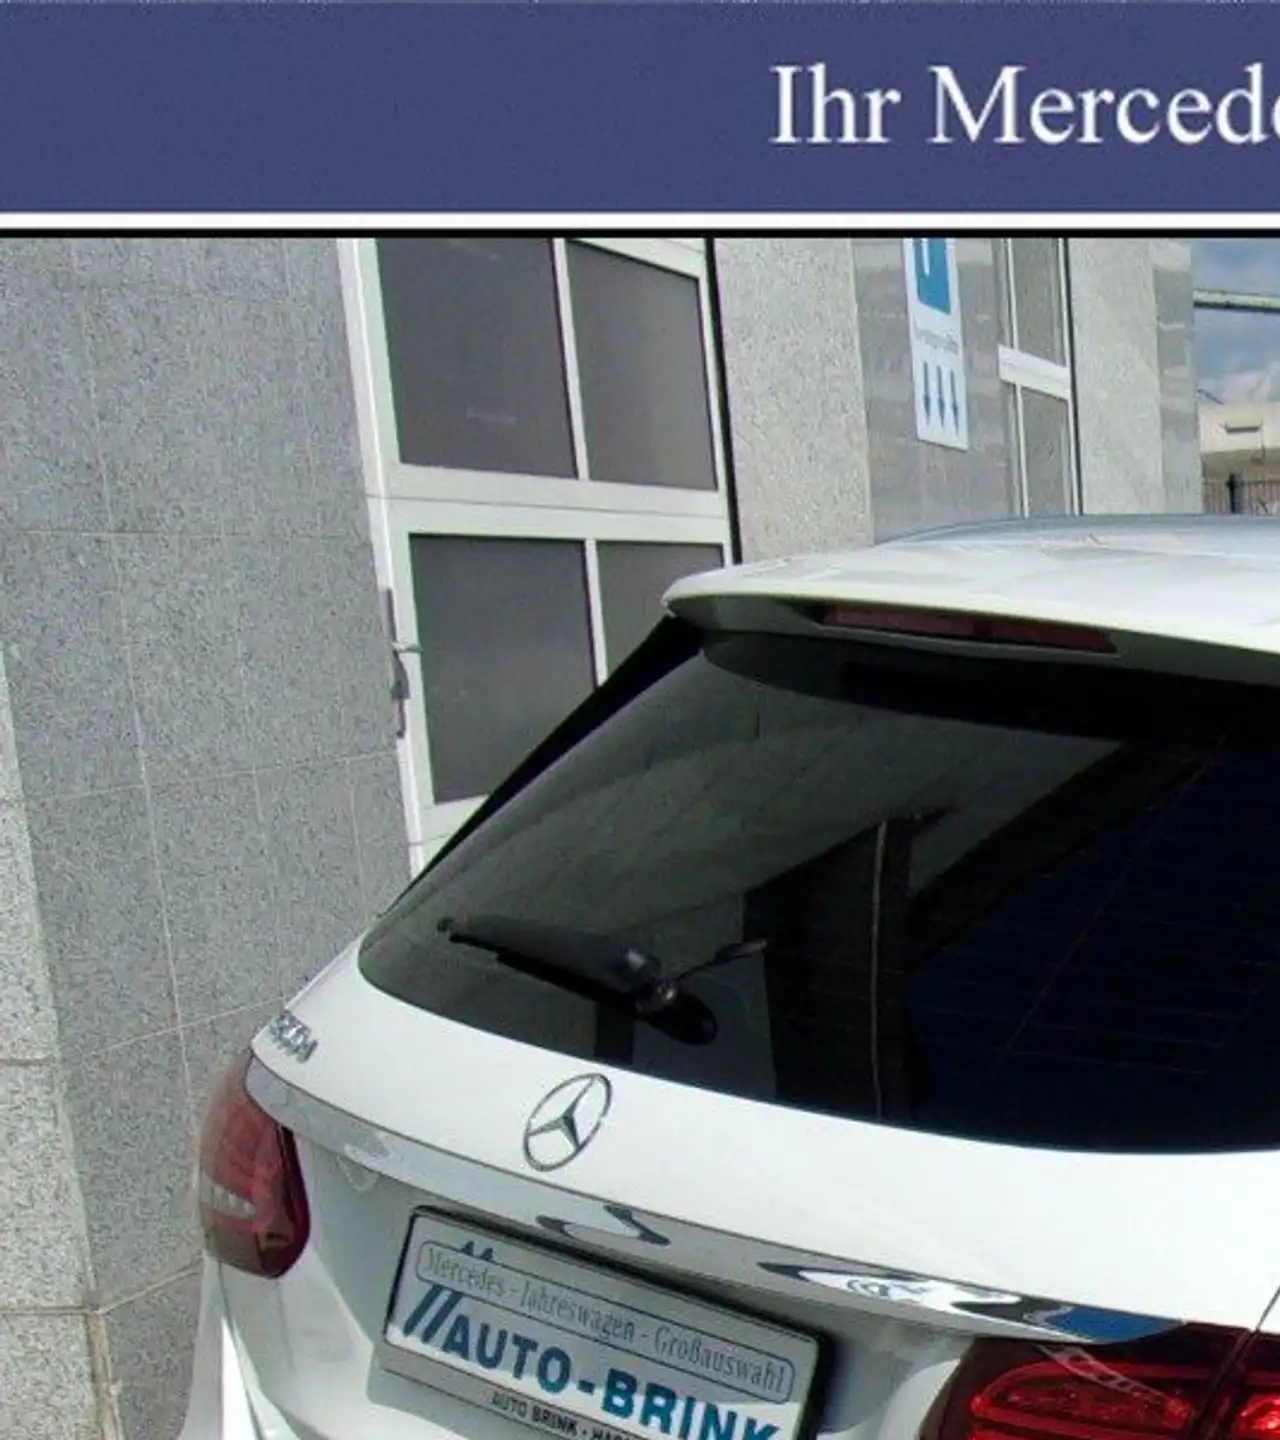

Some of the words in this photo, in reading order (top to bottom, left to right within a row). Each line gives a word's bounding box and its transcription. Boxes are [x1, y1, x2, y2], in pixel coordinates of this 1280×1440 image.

[424, 1247, 505, 1297] Mercedes
[519, 1279, 635, 1343] Jahreswagen
[655, 1325, 786, 1395] Großauswahl
[491, 1391, 527, 1418] AUTO
[531, 1404, 578, 1437] BRINK
